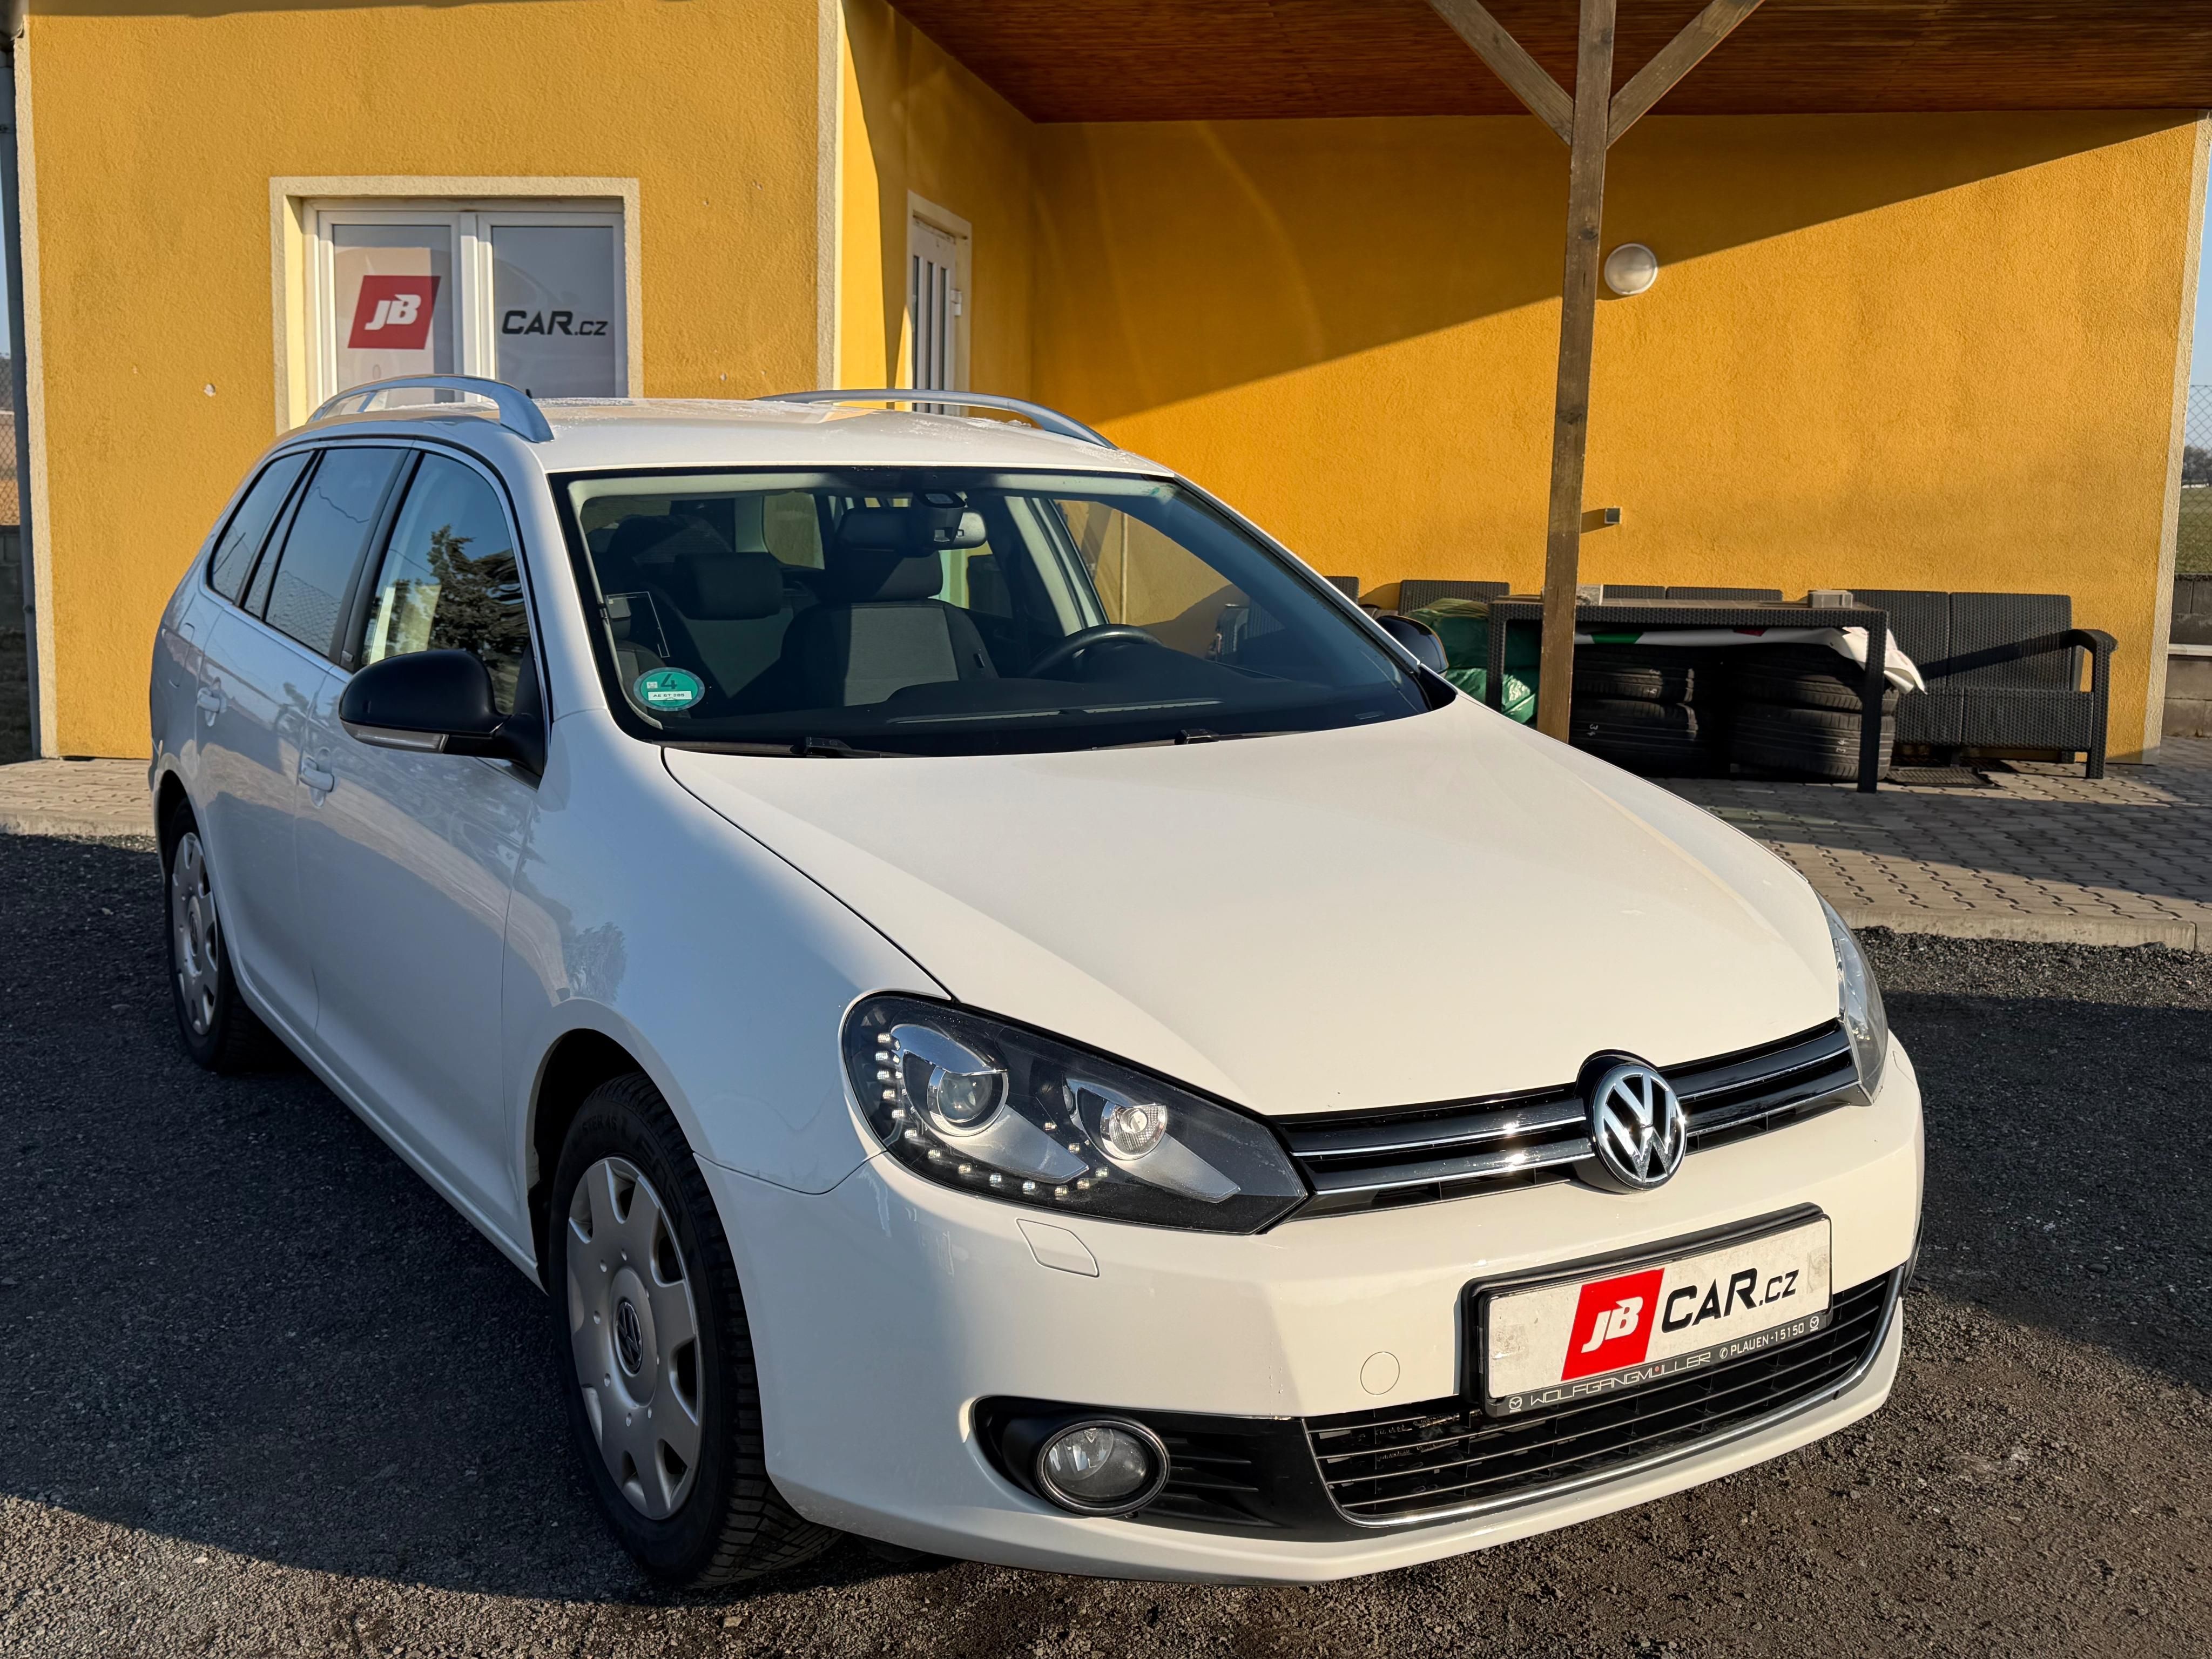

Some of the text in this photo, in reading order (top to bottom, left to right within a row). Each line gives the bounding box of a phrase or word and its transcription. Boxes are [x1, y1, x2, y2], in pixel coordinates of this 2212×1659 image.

[365, 293, 421, 331] JB
[660, 673, 677, 690] 4
[1581, 1296, 1643, 1353] JB
